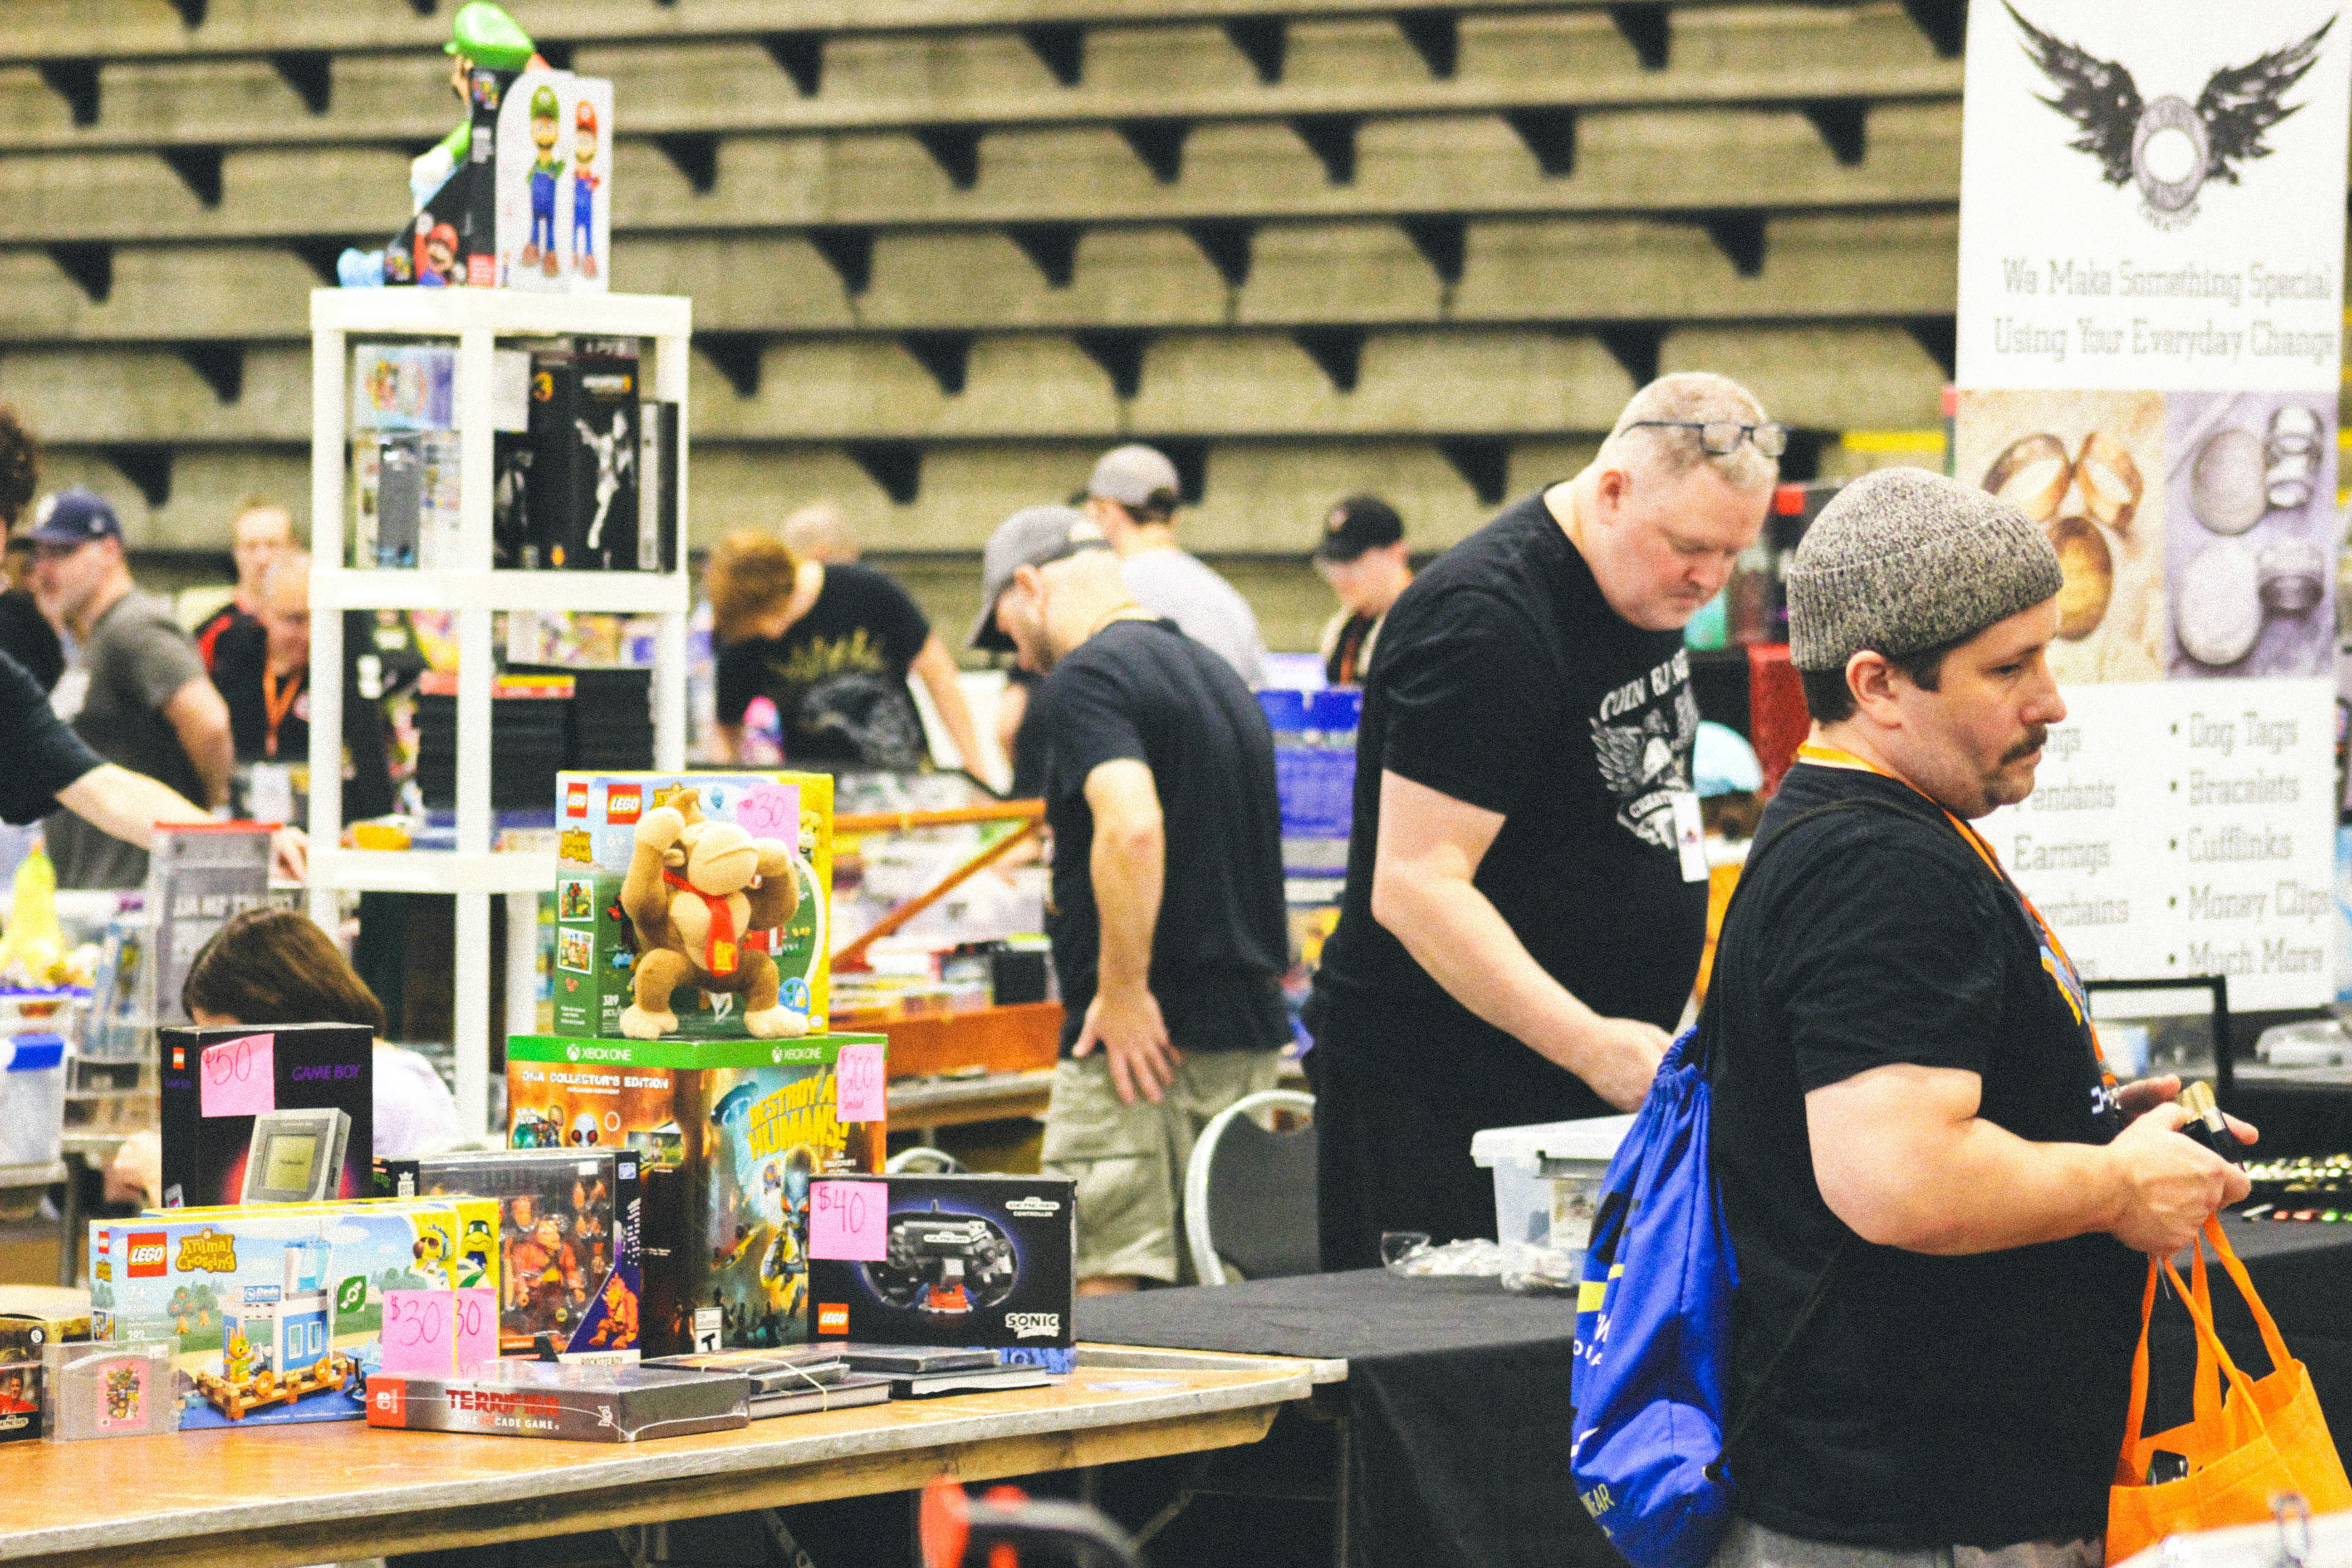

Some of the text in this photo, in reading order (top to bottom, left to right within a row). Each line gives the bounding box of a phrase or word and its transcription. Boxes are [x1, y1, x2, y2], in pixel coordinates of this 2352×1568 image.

[2002, 257, 2332, 307] We Make Something Special
[1994, 317, 2068, 363] Using
[2077, 318, 2124, 354] Your
[2132, 318, 2244, 364] Everyday
[2190, 710, 2299, 757] Dog Tags
[609, 796, 640, 812] LEGO
[2015, 777, 2117, 811] endants
[2190, 768, 2301, 806] Bracelets
[2188, 826, 2293, 862] Cufflinks
[2188, 883, 2268, 924] Money
[2188, 938, 2323, 975] Much More
[292, 1063, 362, 1082] GAME BOY
[549, 1072, 620, 1088] COLLECTOR'S
[624, 1076, 669, 1090] EDITION
[749, 1075, 822, 1129] DESTROY
[747, 1104, 851, 1161] HUMANS!
[818, 1185, 864, 1234] $40
[130, 1246, 165, 1264] LEGO
[176, 1251, 235, 1273] Crossing
[182, 1236, 232, 1256] Animal
[390, 1295, 441, 1347] $30
[821, 1313, 847, 1324] LEGO
[1007, 1314, 1058, 1327] SONIC
[701, 1332, 716, 1352] T
[445, 1389, 560, 1418] TERRIFIER
[524, 1419, 553, 1430] GAME
